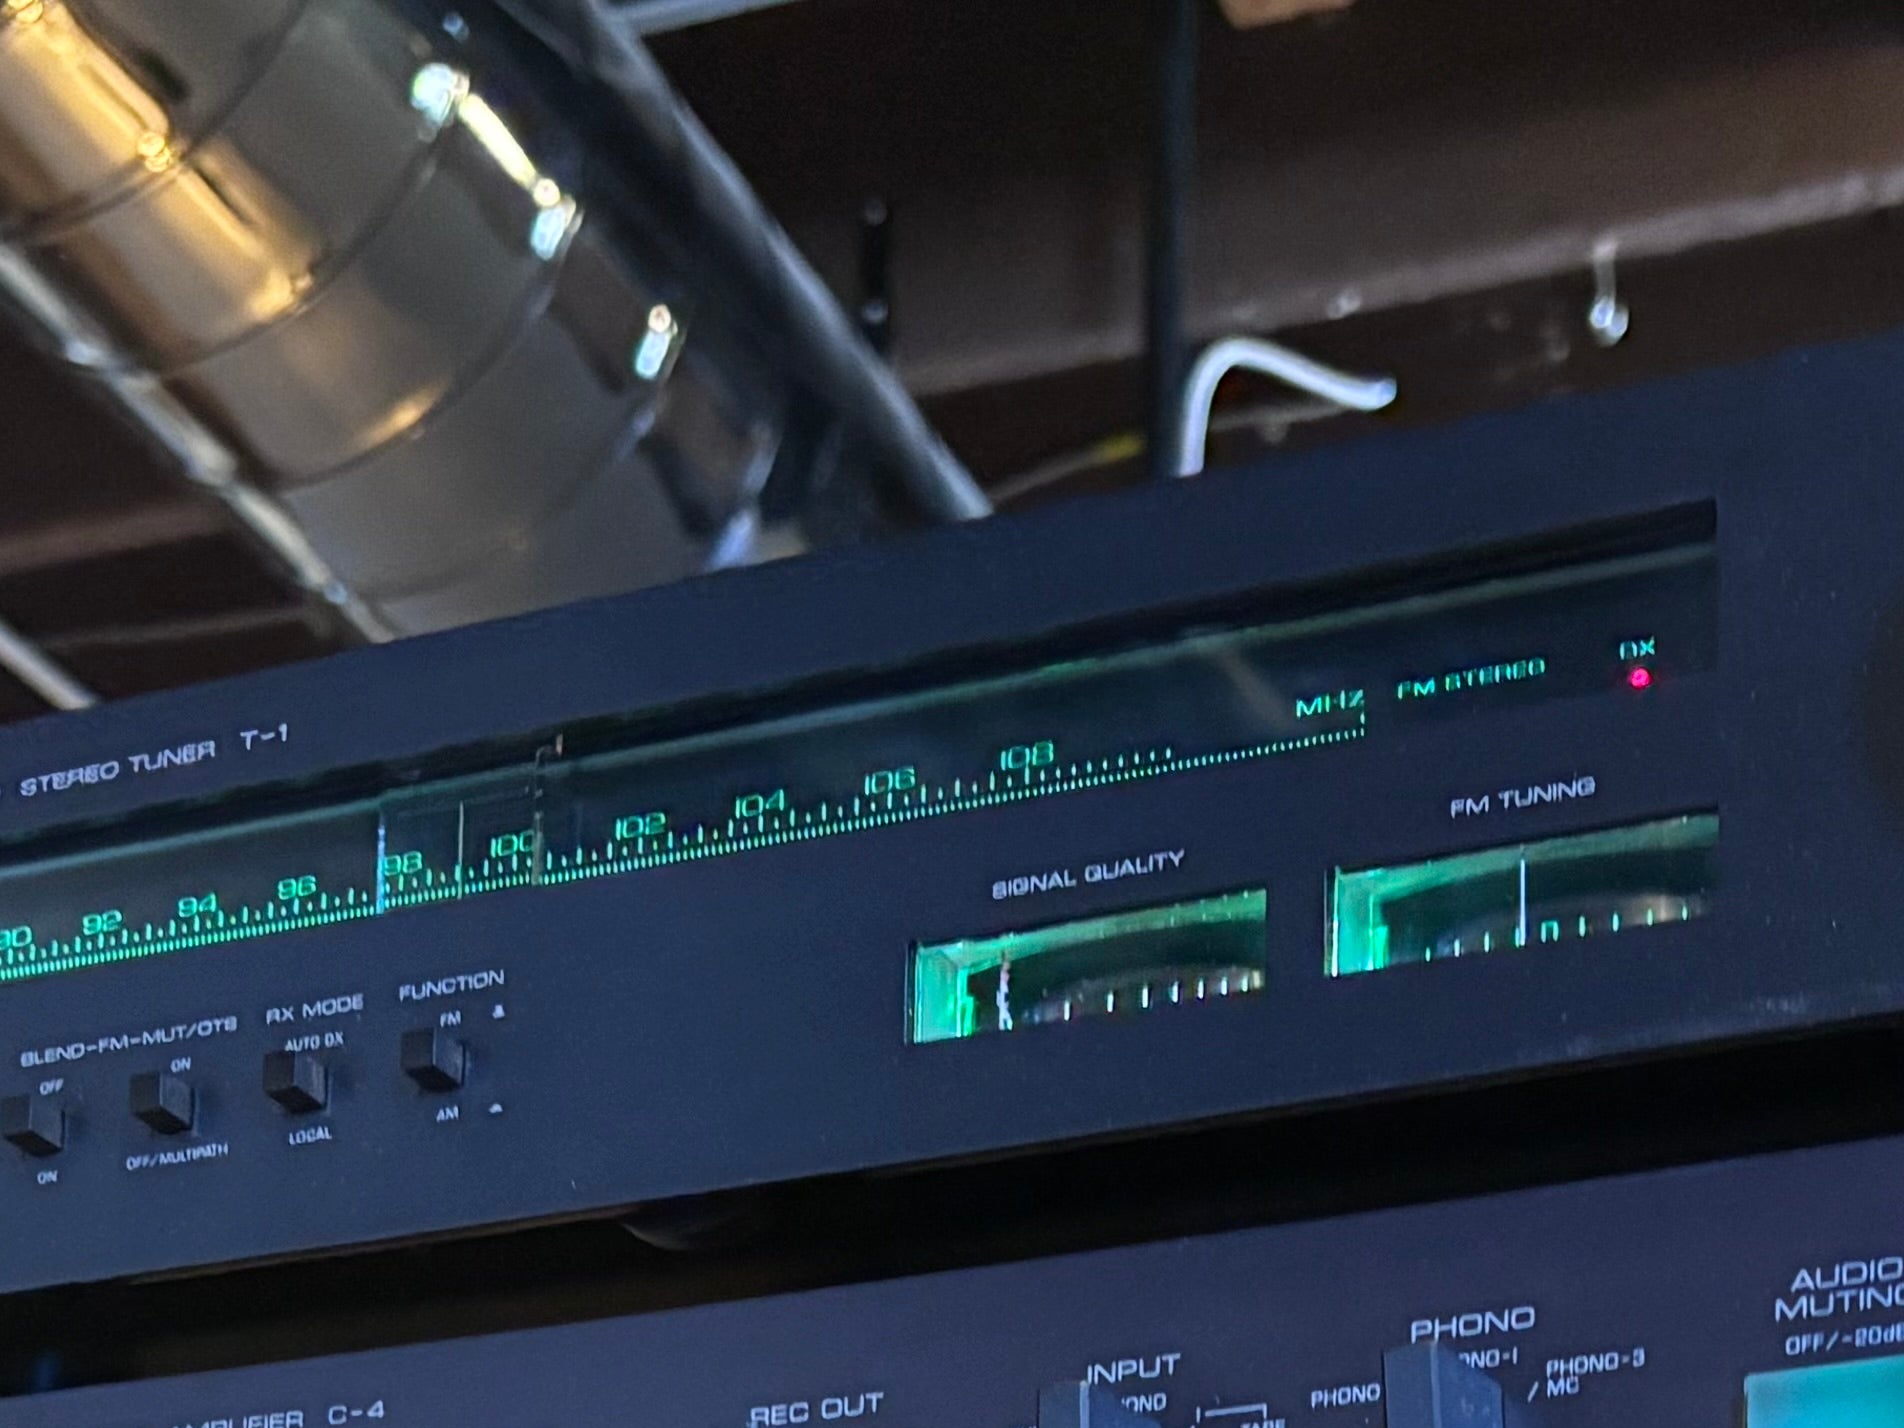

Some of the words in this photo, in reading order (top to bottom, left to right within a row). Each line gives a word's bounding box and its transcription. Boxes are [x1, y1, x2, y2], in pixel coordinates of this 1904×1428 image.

[1397, 677, 1436, 700] FM
[20, 761, 119, 797] STEREO
[129, 740, 216, 773] TUNER
[241, 723, 288, 750] T-1
[1451, 795, 1488, 819] FM
[1498, 776, 1595, 808] TUNING
[83, 910, 122, 935] 92
[178, 893, 217, 917] 94
[278, 875, 316, 900] 96
[383, 851, 422, 876] 98
[490, 831, 536, 856] 100
[615, 813, 666, 840] 102
[734, 789, 785, 818] 104
[864, 767, 915, 795] 106
[1000, 740, 1054, 770] 108
[992, 869, 1077, 900] SIGNAL
[1085, 849, 1185, 882] QUALITY
[399, 969, 505, 1001] FUNCTION
[302, 993, 365, 1019] MODE
[440, 1011, 462, 1028] FM
[284, 1034, 319, 1053] AUTO
[171, 1057, 191, 1072] ON
[39, 1078, 65, 1096] OFF
[436, 1106, 460, 1122] AM
[288, 1126, 332, 1147] LOCAL
[1791, 1256, 1903, 1293] AUDIO
[1410, 1306, 1536, 1344] PHONO
[1087, 1353, 1180, 1384] INPUT
[1310, 1383, 1381, 1409] PHONO
[1546, 1375, 1579, 1398] MC
[328, 1400, 384, 1426] C-4
[751, 1402, 809, 1427] REC
[821, 1392, 884, 1420] OUT
